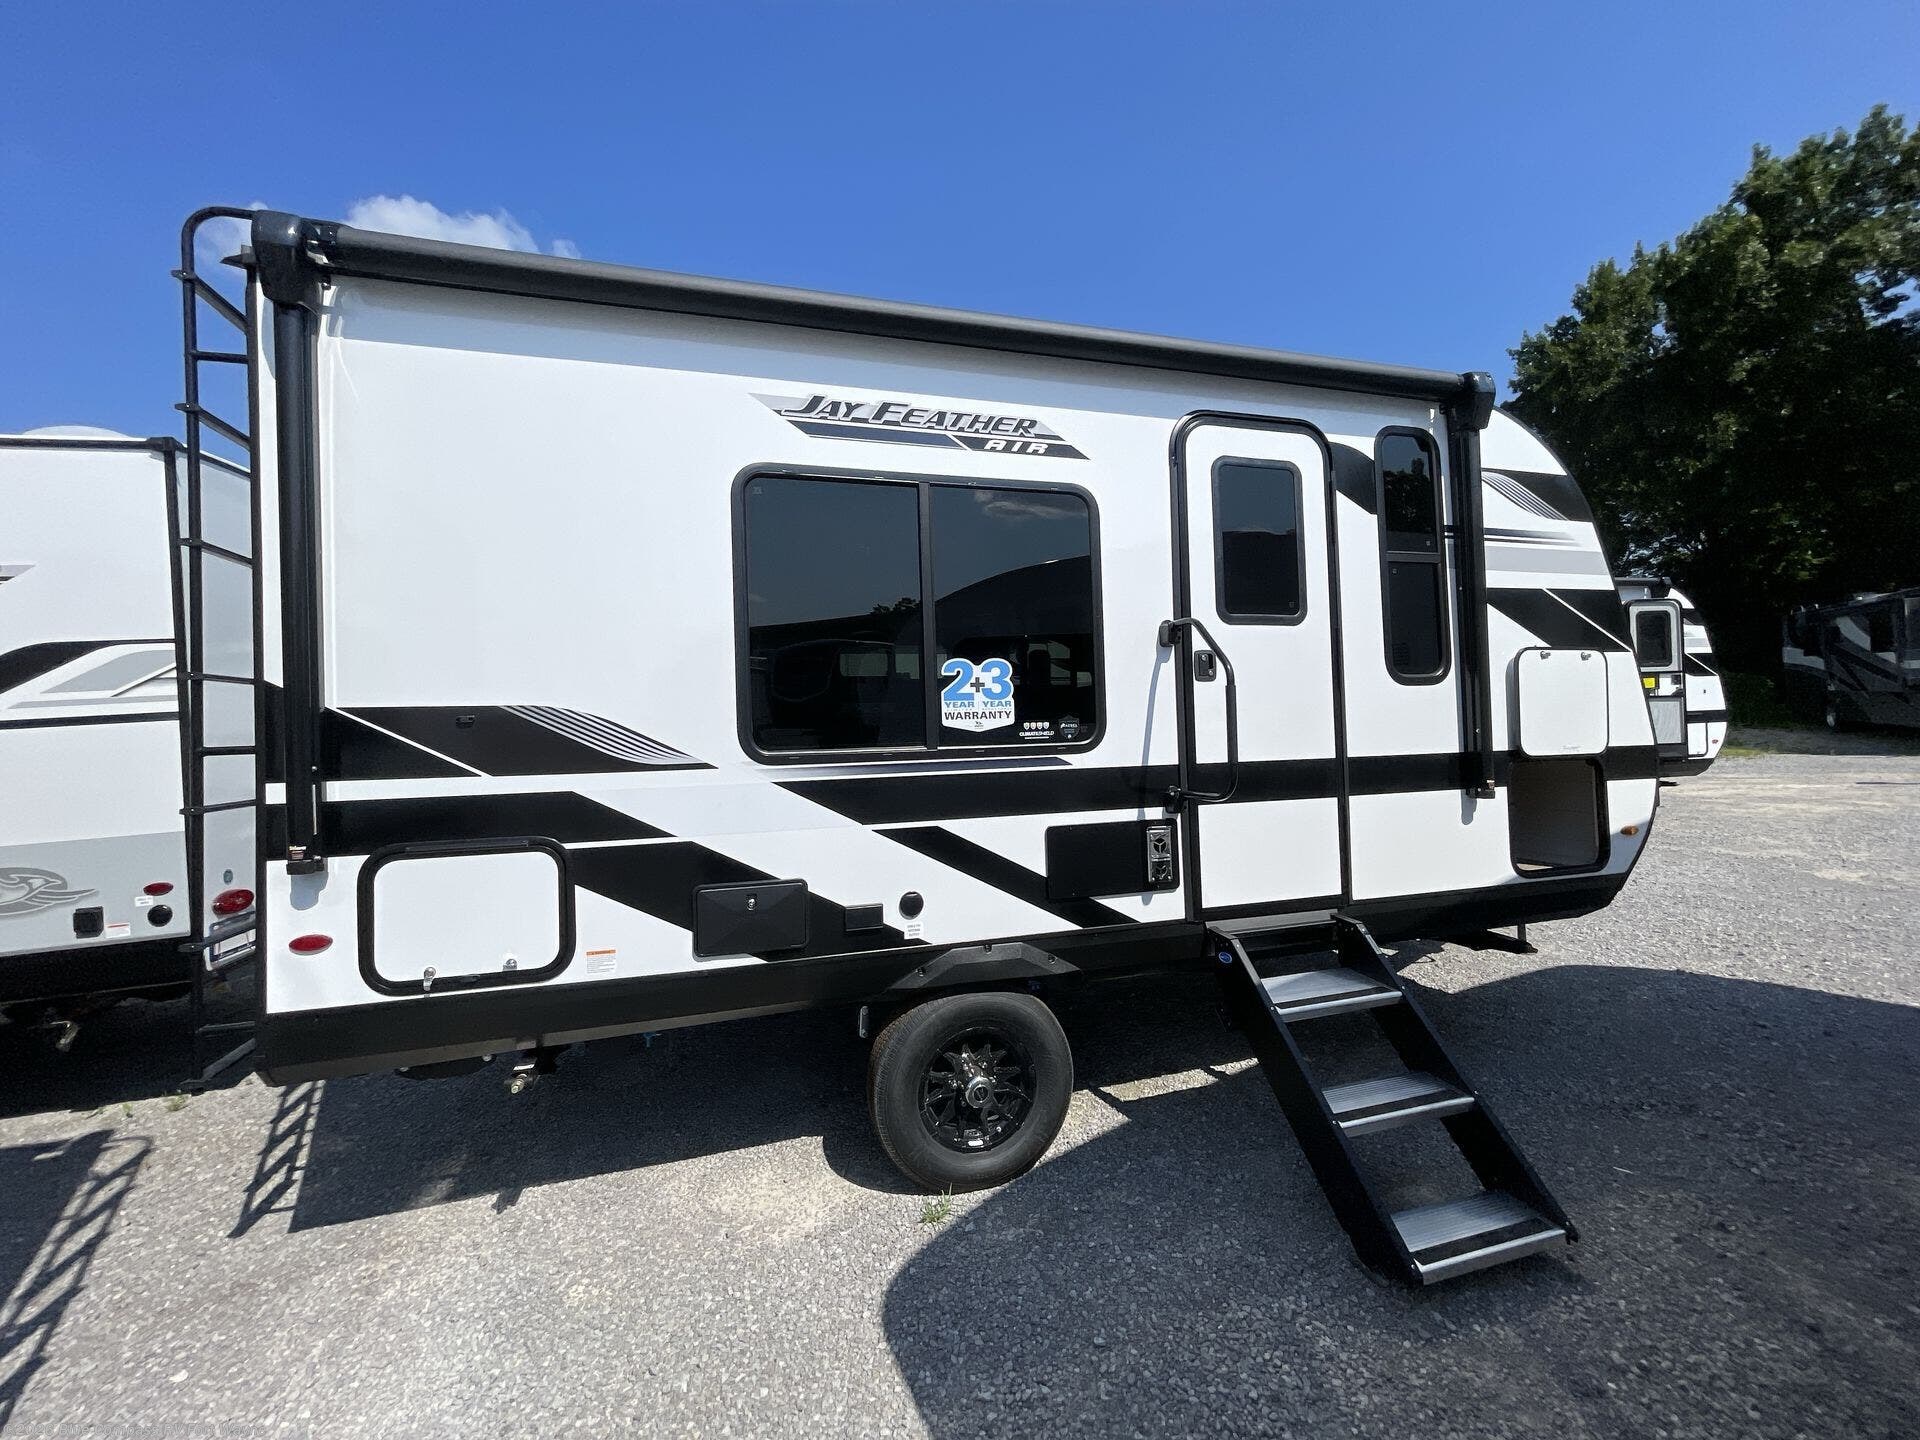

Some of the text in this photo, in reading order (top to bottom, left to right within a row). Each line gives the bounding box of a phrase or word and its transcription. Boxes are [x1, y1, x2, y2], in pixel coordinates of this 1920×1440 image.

[783, 395, 1038, 438] JAY FEATHER
[983, 439, 1049, 455] AIR
[982, 700, 1012, 708] YEAR
[944, 710, 1012, 720] WARRANTY
